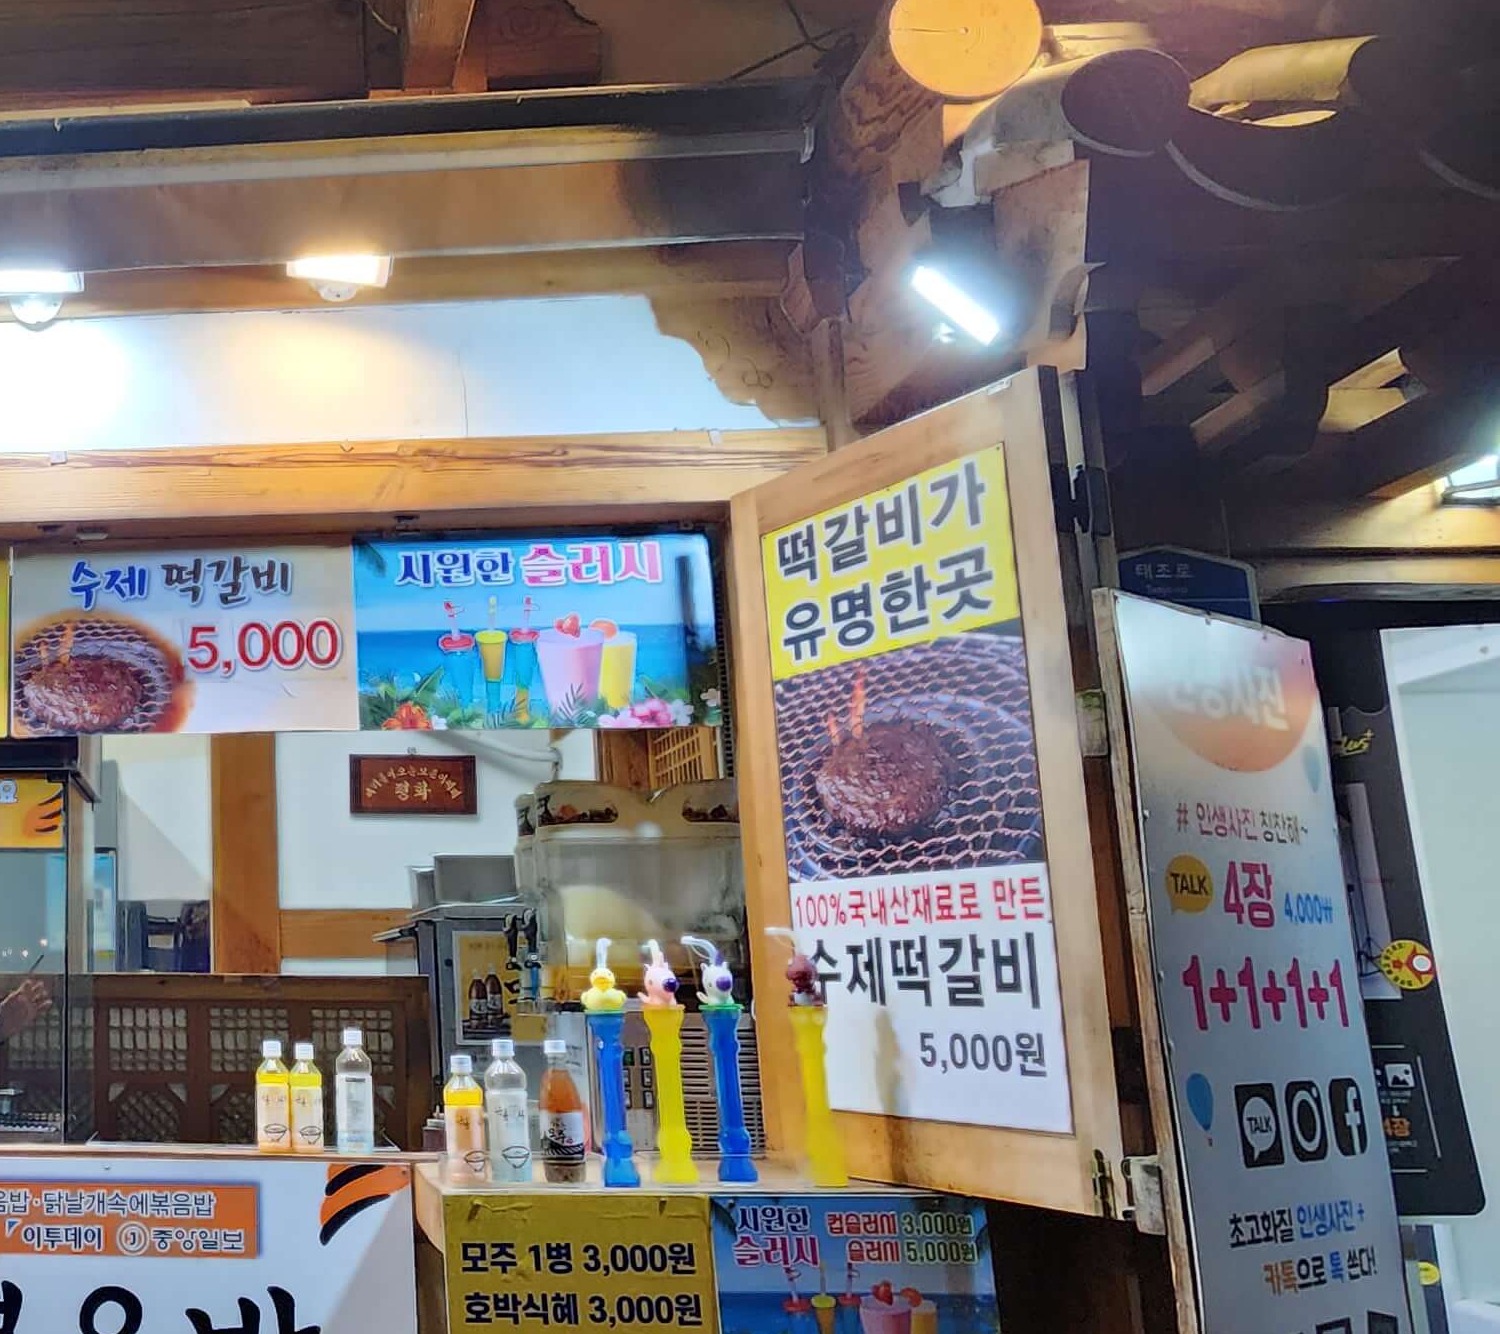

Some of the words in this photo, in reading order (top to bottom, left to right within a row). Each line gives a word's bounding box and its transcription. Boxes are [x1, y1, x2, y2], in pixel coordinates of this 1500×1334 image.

[775, 459, 988, 583] 떡갈비가
[70, 559, 147, 609] 수제
[162, 554, 293, 605] 떡갈비
[398, 550, 516, 587] 시원한
[521, 541, 663, 586] 슬러시
[781, 543, 994, 663] 유명한곳
[186, 617, 340, 673] 5,000
[1195, 802, 1258, 841] 인생사진
[796, 884, 981, 929] 100%국내산재료로
[992, 876, 1045, 920] 만든
[1170, 872, 1209, 897] TALK
[1223, 860, 1275, 929] 4장
[810, 931, 1041, 1009] 수제떡갈비
[1176, 954, 1349, 1031] 1+1+1+1
[919, 1031, 1047, 1077] 5,000원
[1247, 1116, 1272, 1134] TALK
[23, 1225, 103, 1251] 이투데이
[151, 1228, 245, 1252] 중앙일보
[737, 1207, 811, 1235] 시원한
[902, 1212, 975, 1237] 3,000원
[1229, 1207, 1294, 1249] 초고화질
[460, 1241, 518, 1277] 모주
[528, 1241, 573, 1276] 1병
[583, 1241, 698, 1279] 3,000원
[733, 1235, 821, 1268] 슬러시
[850, 1240, 901, 1262] 슬러시
[906, 1240, 978, 1264] 5,000원
[1263, 1255, 1327, 1296] 카톡으로
[1329, 1251, 1345, 1283] 톡
[464, 1292, 580, 1328] 호박식혜
[588, 1292, 704, 1330] 3,000원
